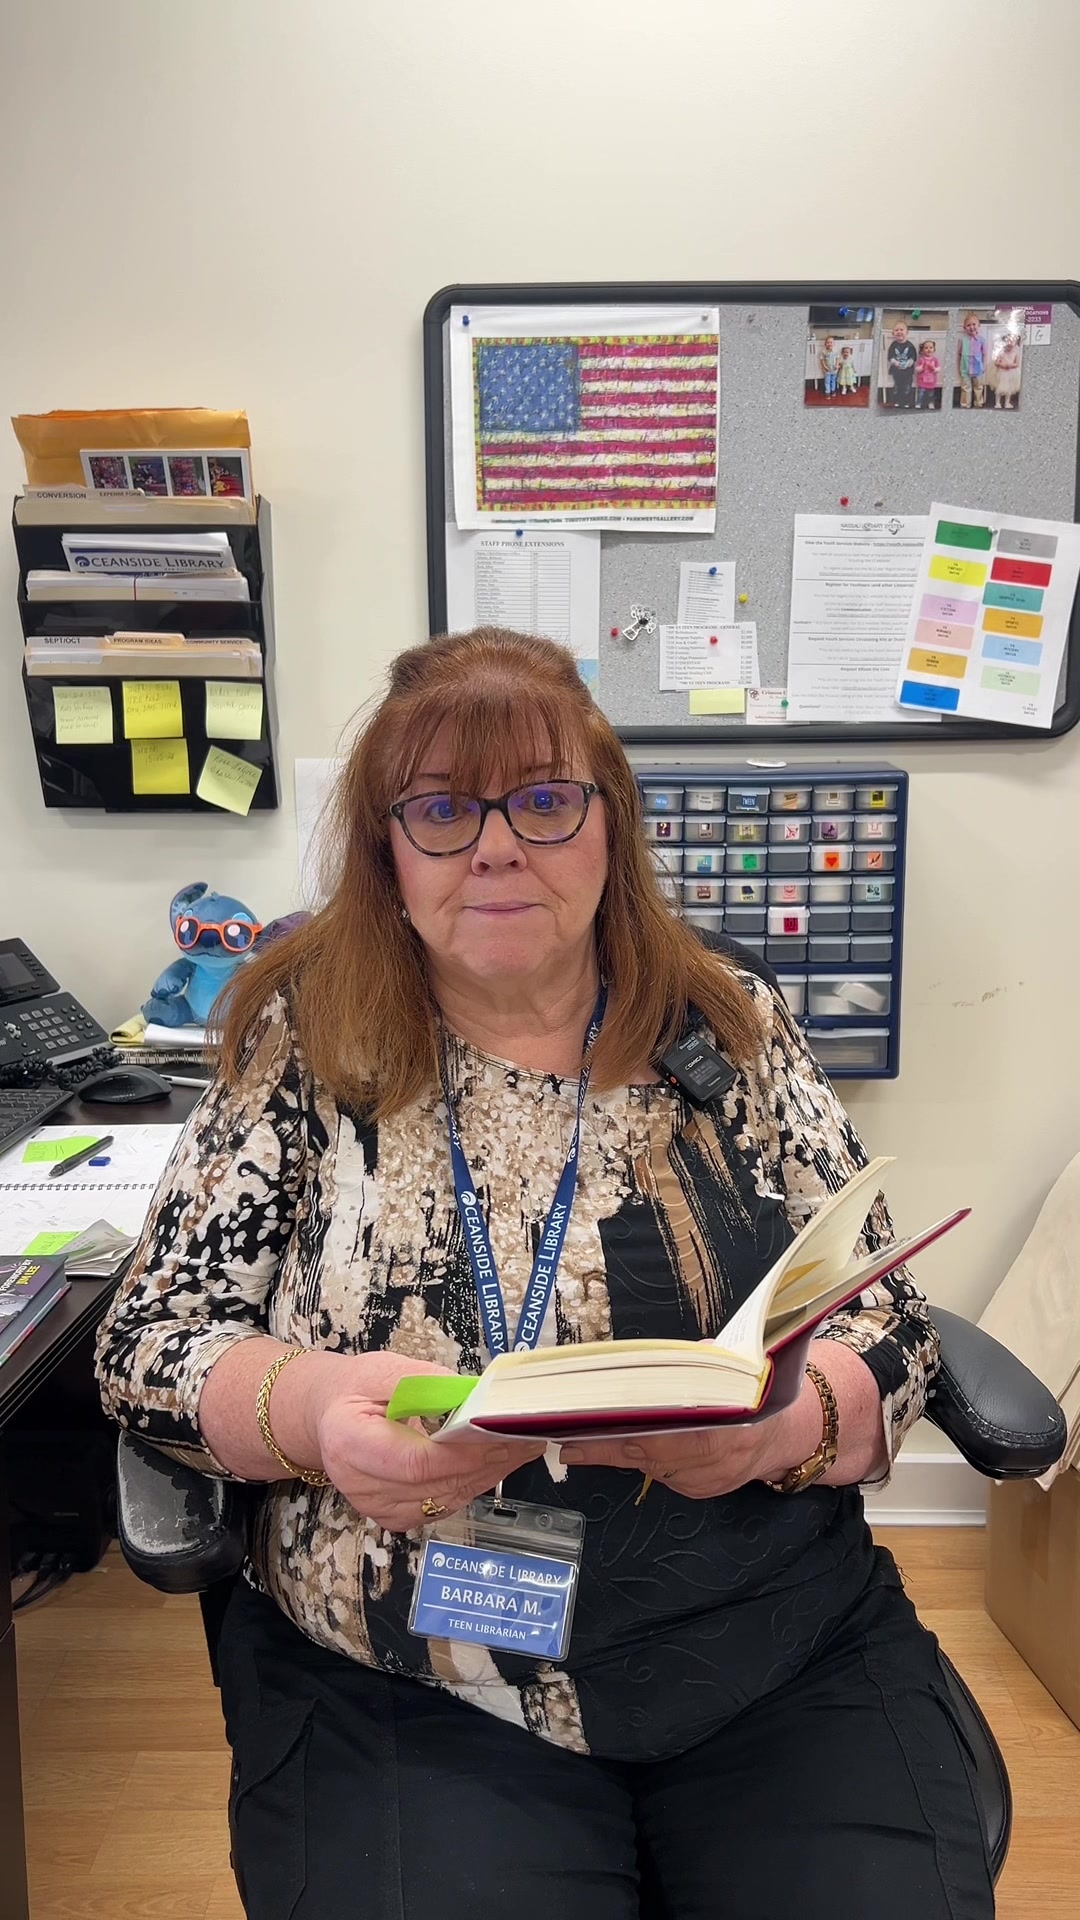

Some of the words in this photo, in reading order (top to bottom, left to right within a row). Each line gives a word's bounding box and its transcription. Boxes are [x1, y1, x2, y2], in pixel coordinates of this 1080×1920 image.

[36, 491, 87, 499] CONVERSION
[538, 1202, 568, 1262] LIBRARY
[24, 1265, 41, 1275] LEE
[482, 1282, 505, 1352] LIBRARY
[509, 1565, 562, 1586] LIBRARY
[441, 1585, 518, 1612] BARBARA
[523, 1600, 542, 1616] M.
[448, 1618, 473, 1631] TEEN
[475, 1623, 526, 1640] LIBRARIAN
